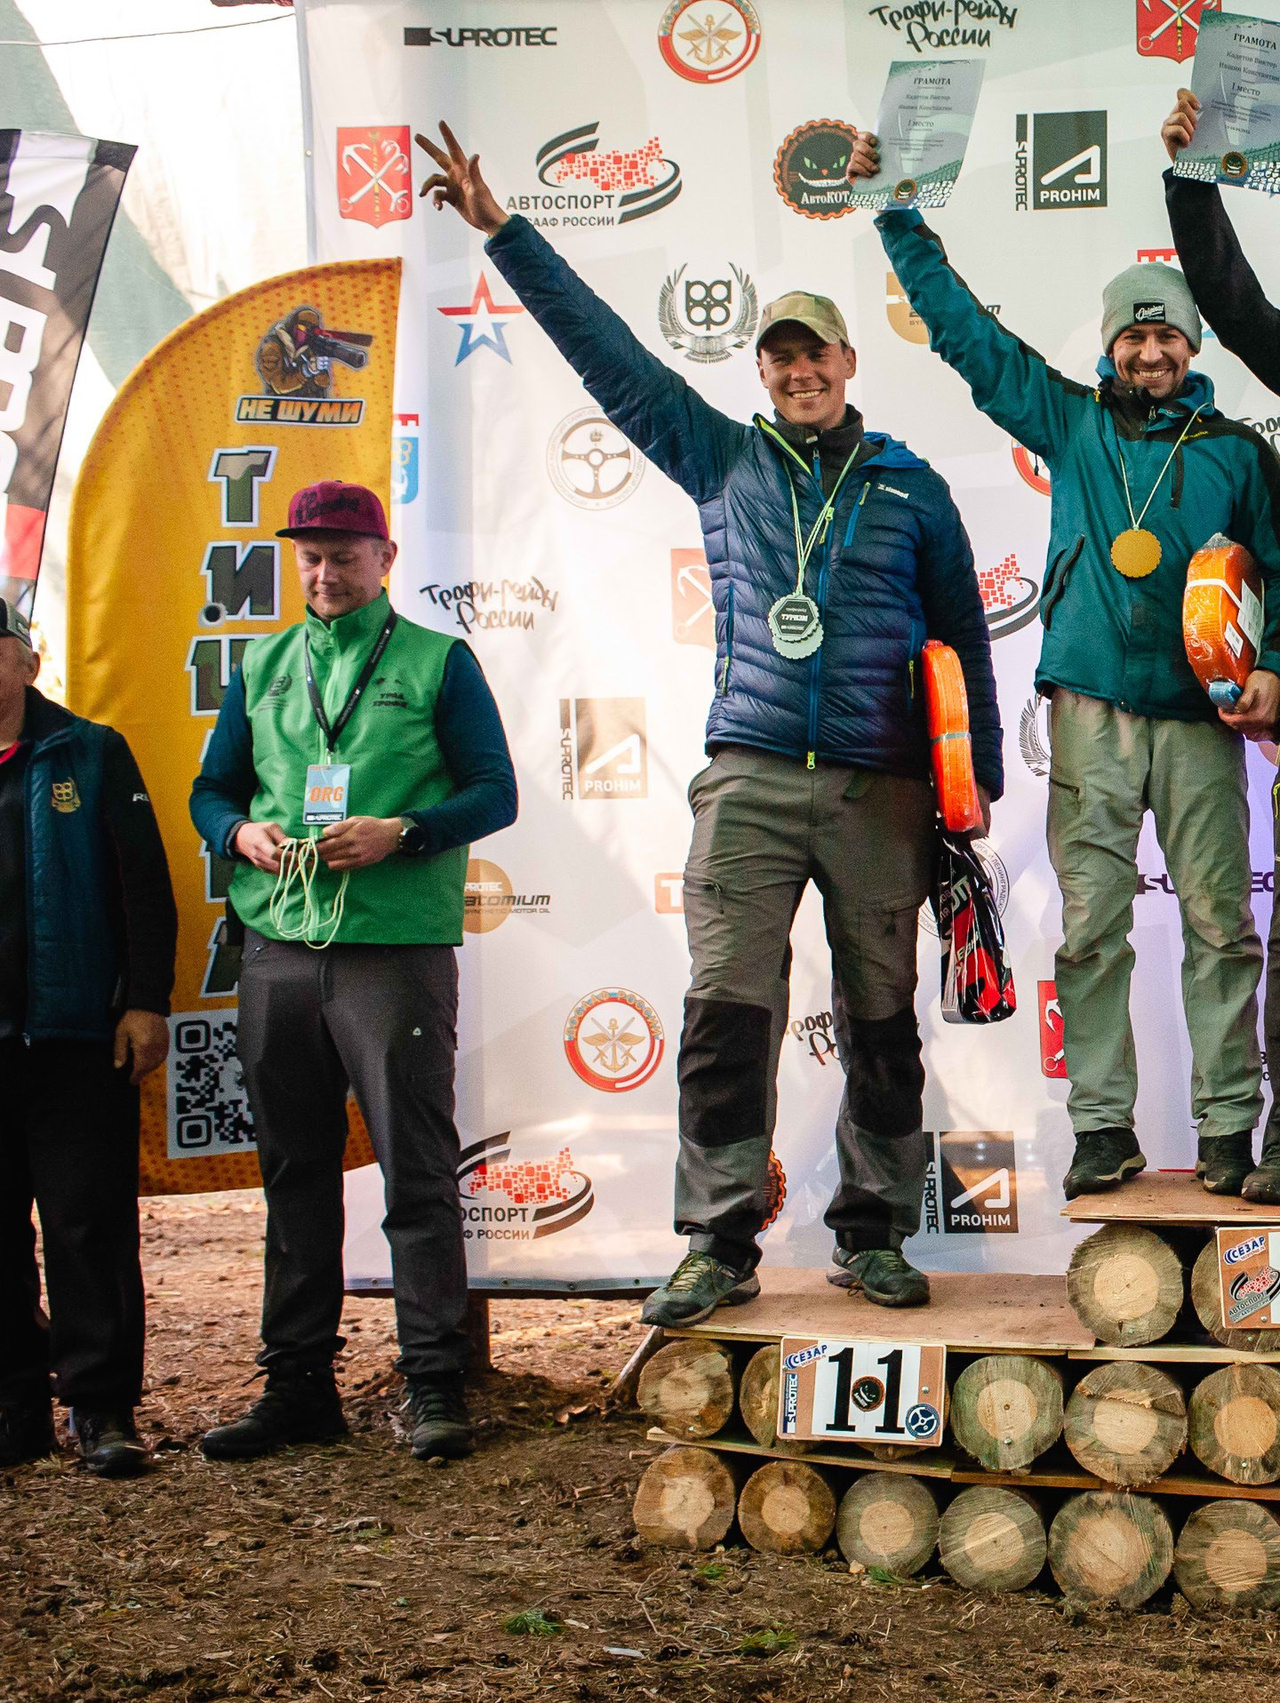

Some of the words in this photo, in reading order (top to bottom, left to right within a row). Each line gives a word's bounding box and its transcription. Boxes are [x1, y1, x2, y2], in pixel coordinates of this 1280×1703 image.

[429, 27, 557, 46] SUPROTEC
[906, 22, 991, 52] России
[1234, 33, 1277, 50] ГРАМОТА
[1015, 140, 1028, 211] SUPROTEC
[506, 195, 615, 210] АВТОСПОРТ
[801, 191, 850, 204] АвтоКОТ
[1040, 188, 1100, 203] PROHIM
[527, 217, 559, 227] СААФ
[562, 216, 615, 227] РОССИИ
[238, 398, 271, 421] НЕ
[276, 400, 362, 423] ШУМИ
[456, 599, 536, 634] России
[560, 728, 573, 800] SUPROTEC
[310, 786, 345, 802] ORG
[584, 779, 641, 793] PROHIM
[465, 882, 502, 891] PROTEC
[461, 1207, 529, 1223] ОСПОРТ
[951, 1214, 1011, 1226] PROHIM
[477, 1228, 530, 1240] РОССИИ
[787, 1373, 798, 1422] SUPROTEC
[826, 1347, 905, 1434] 11
